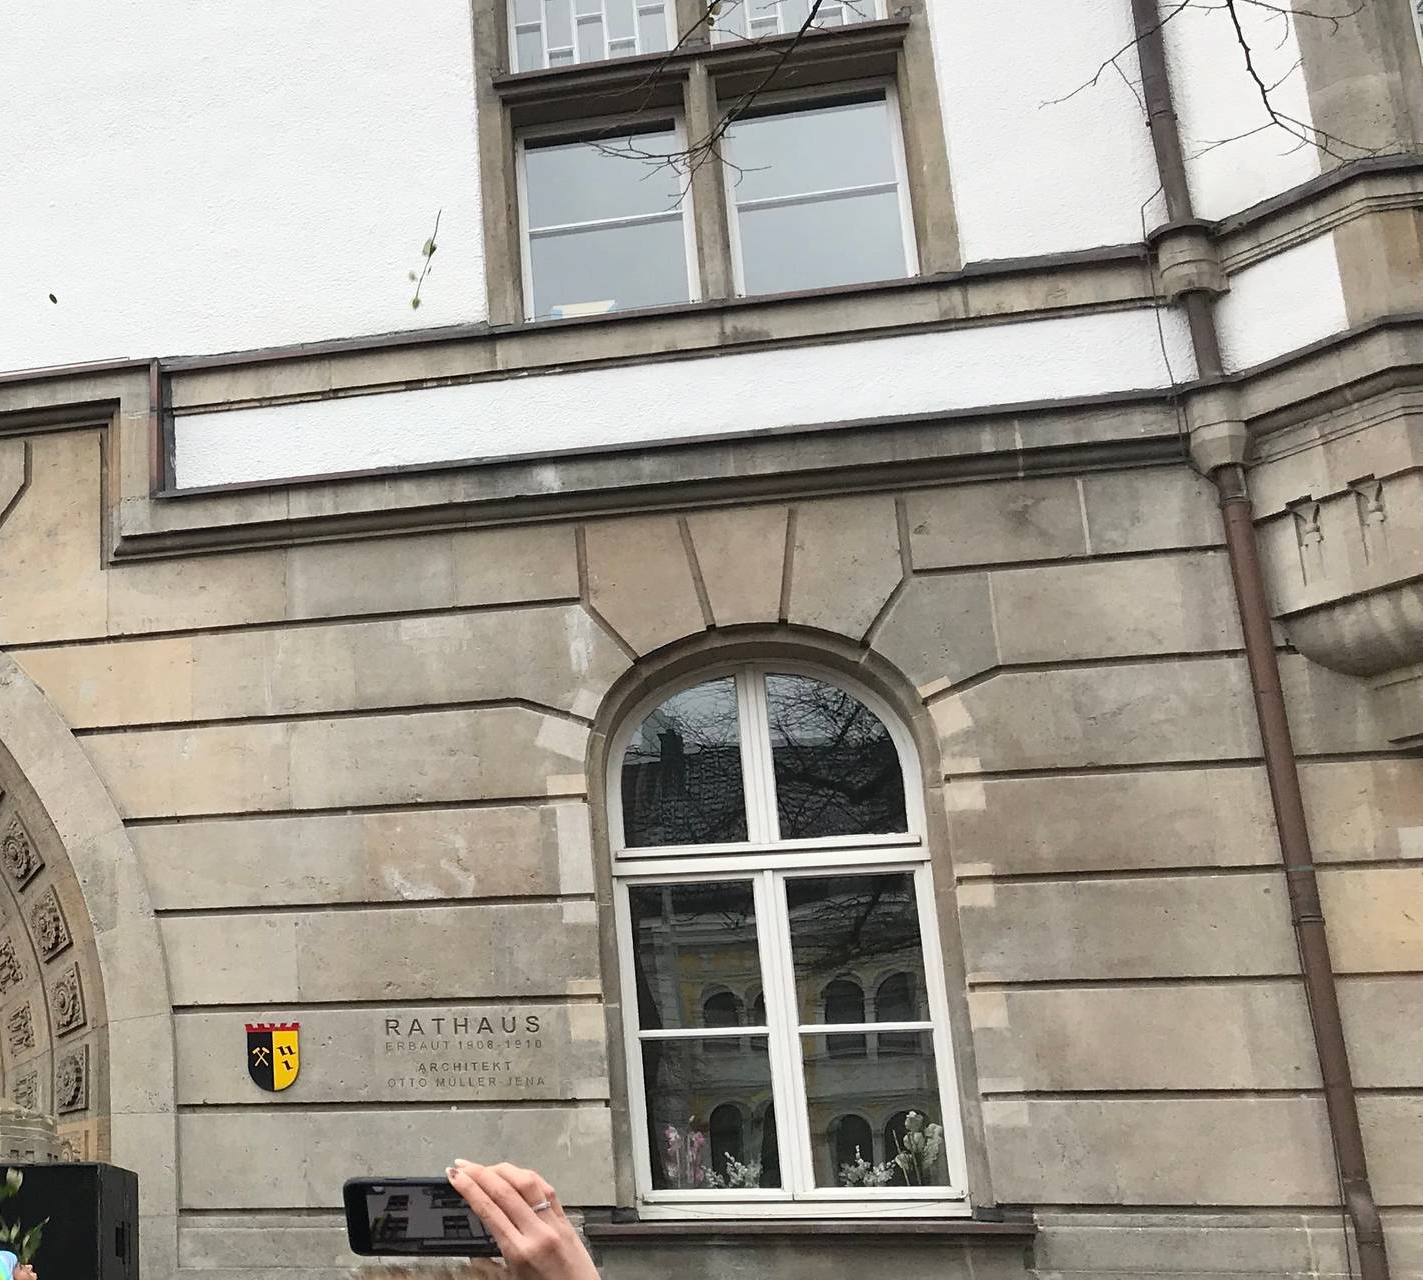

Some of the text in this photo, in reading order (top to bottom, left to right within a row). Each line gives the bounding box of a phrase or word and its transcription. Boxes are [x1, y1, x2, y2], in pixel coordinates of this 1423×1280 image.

[385, 1015, 540, 1036] RATHAUS
[385, 1040, 450, 1051] ERBAUT
[418, 1061, 512, 1073] ARCHITEKT
[388, 1078, 427, 1088] OTTO
